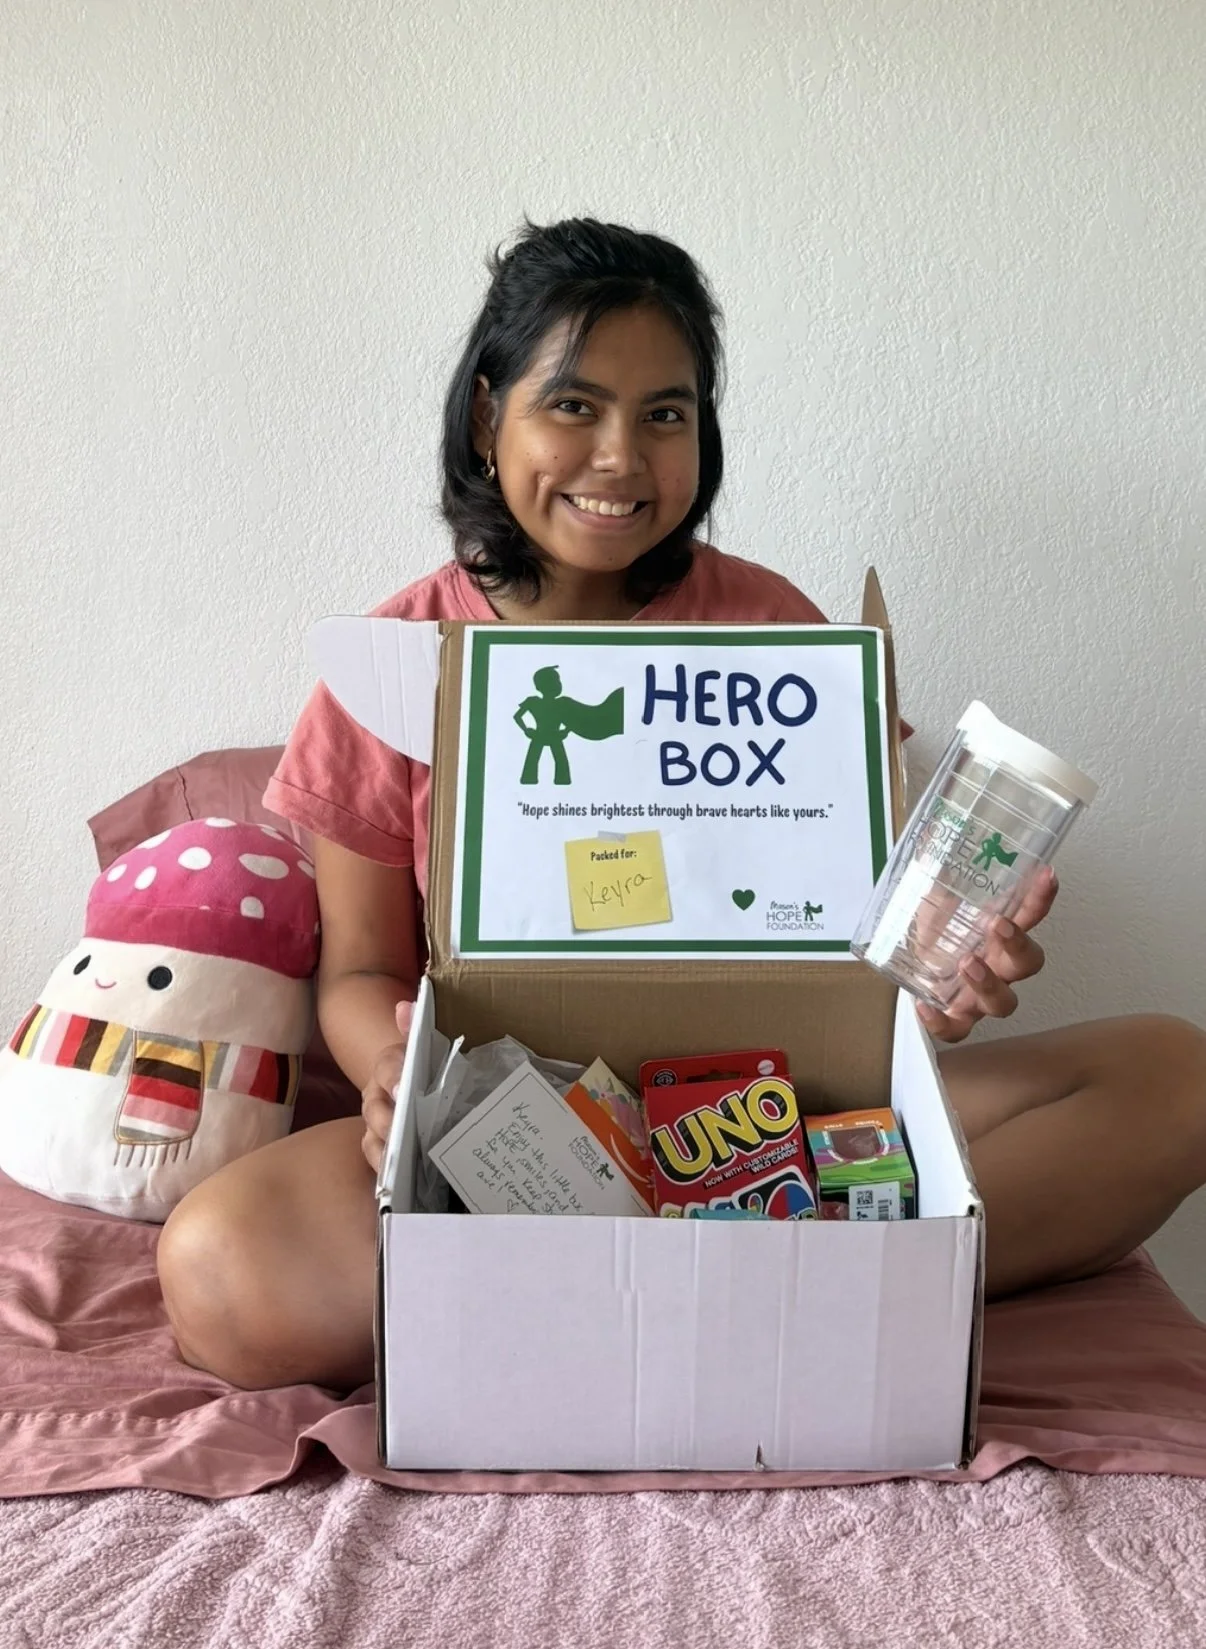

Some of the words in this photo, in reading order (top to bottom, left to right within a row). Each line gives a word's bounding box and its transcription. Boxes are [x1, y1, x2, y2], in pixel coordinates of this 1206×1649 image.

[641, 663, 818, 727] HERO
[660, 738, 786, 787] BOX
[552, 802, 587, 817] shines
[590, 802, 645, 820] brightest
[648, 803, 693, 820] through
[696, 804, 728, 817] brave
[730, 804, 768, 818] hearts
[770, 804, 790, 818] like
[590, 849, 619, 861] Packed
[620, 848, 637, 859] for:
[583, 873, 653, 912] Keyra
[769, 900, 800, 911] Mason's
[766, 911, 802, 921] HOPE
[766, 922, 824, 931] FOUNDATION
[651, 1077, 800, 1184] UNO
[472, 1147, 506, 1180] always
[572, 1137, 600, 1169] HOPE
[704, 1174, 724, 1188] NOW
[723, 1165, 744, 1179] WITH
[743, 1138, 799, 1170] CUSTOMIZABLE
[750, 1160, 772, 1174] WILD
[531, 1147, 549, 1170] this
[549, 1168, 572, 1194] little
